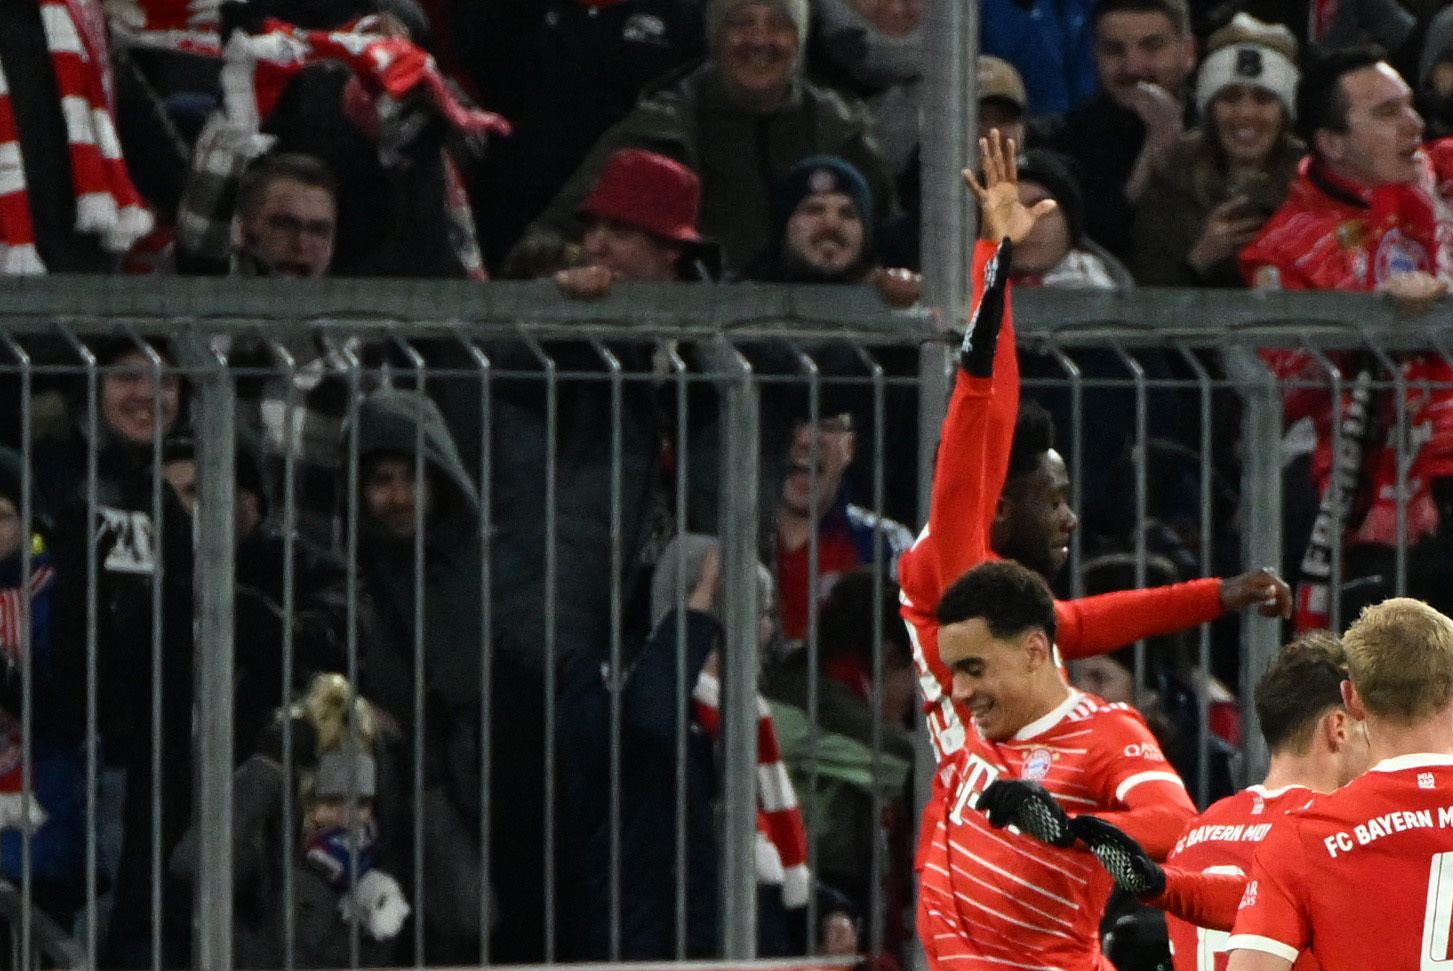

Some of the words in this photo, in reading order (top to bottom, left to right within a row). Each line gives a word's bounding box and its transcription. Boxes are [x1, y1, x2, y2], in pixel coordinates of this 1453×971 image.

[1185, 824, 1246, 849] BAYERN
[1323, 832, 1353, 858] FC
[1353, 809, 1434, 845] BAYERN
